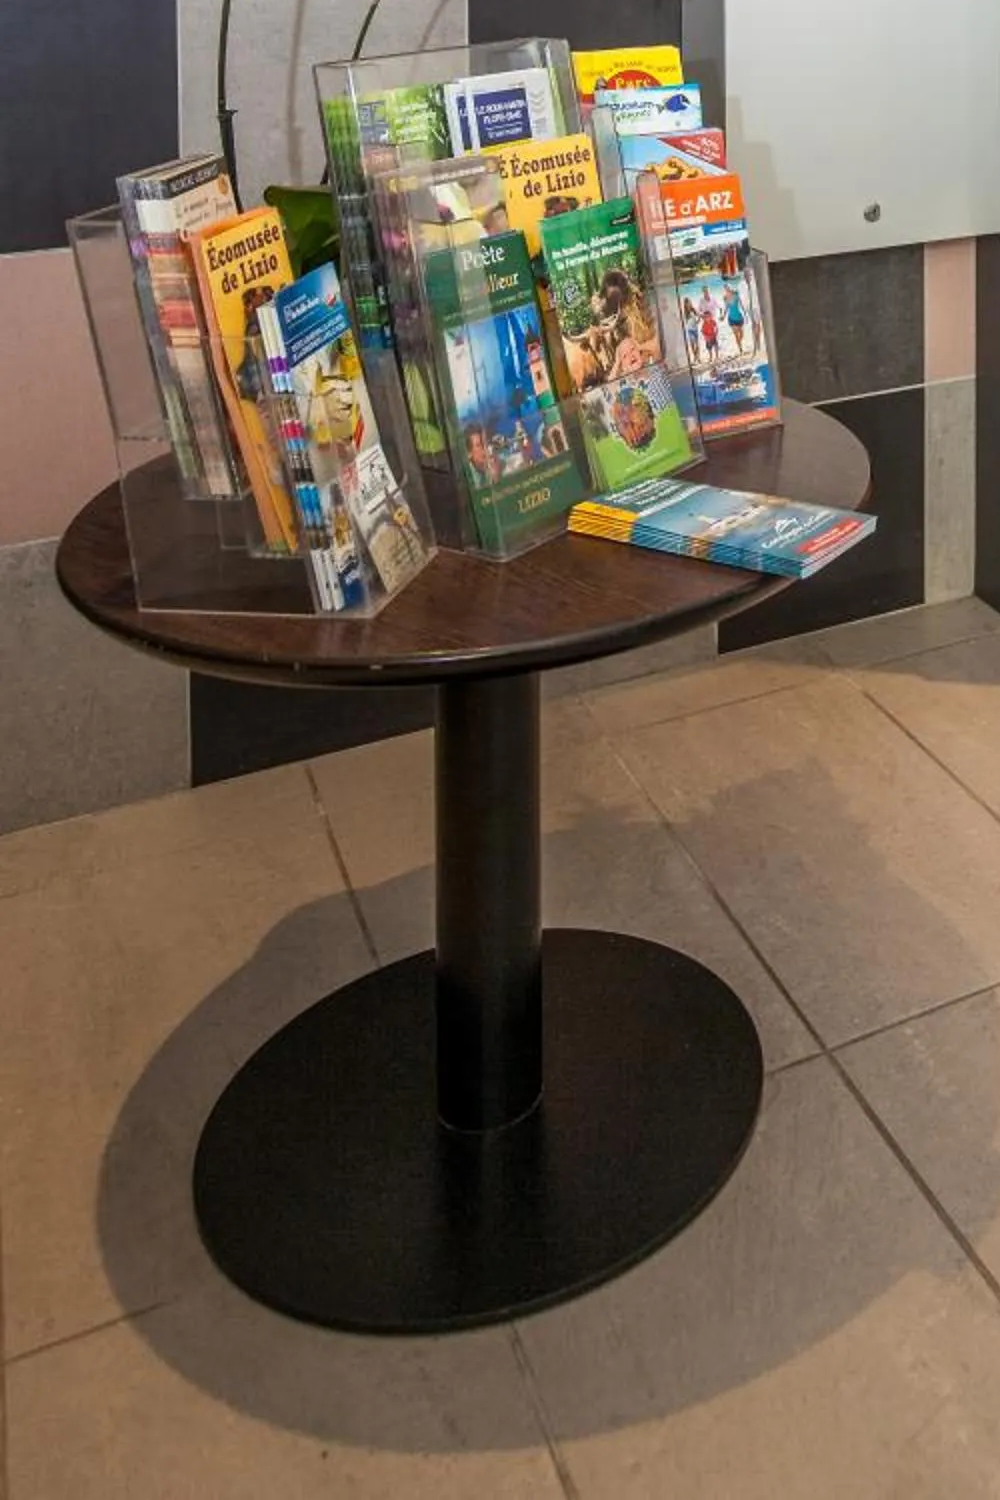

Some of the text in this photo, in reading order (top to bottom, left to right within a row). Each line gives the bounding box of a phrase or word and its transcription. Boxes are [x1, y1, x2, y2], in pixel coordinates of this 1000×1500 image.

[509, 145, 591, 178] Écomusée
[523, 170, 586, 198] de Lizio
[206, 222, 281, 273] Écomusée
[220, 252, 279, 295] de Lizio
